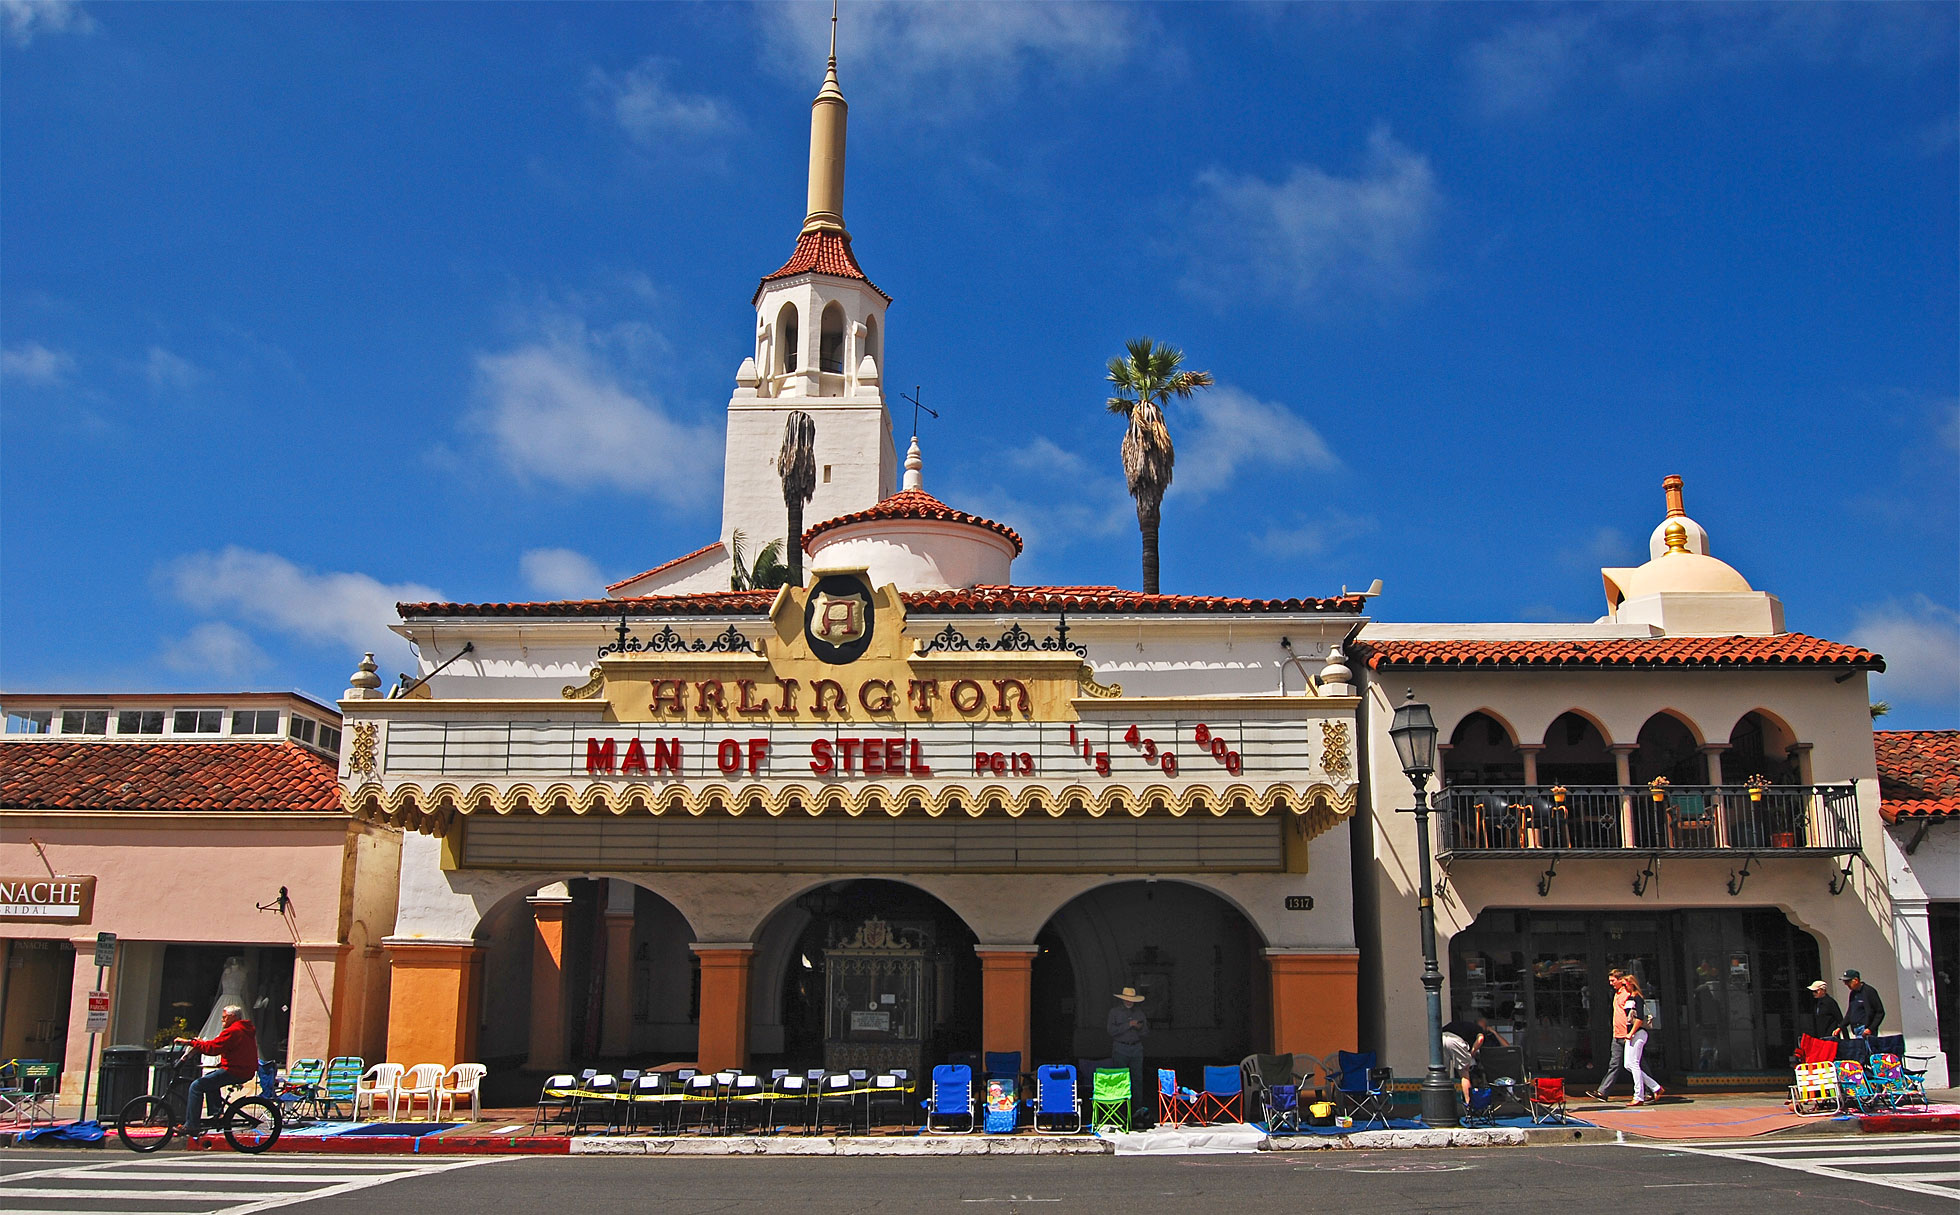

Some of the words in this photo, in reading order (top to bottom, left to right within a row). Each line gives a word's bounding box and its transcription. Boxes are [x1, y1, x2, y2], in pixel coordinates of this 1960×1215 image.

[820, 601, 858, 635] A
[649, 675, 1034, 713] ARLINGTON
[585, 738, 680, 773] MAN
[717, 738, 769, 773] OF
[809, 738, 930, 774] STEEL
[1289, 898, 1310, 908] 1317
